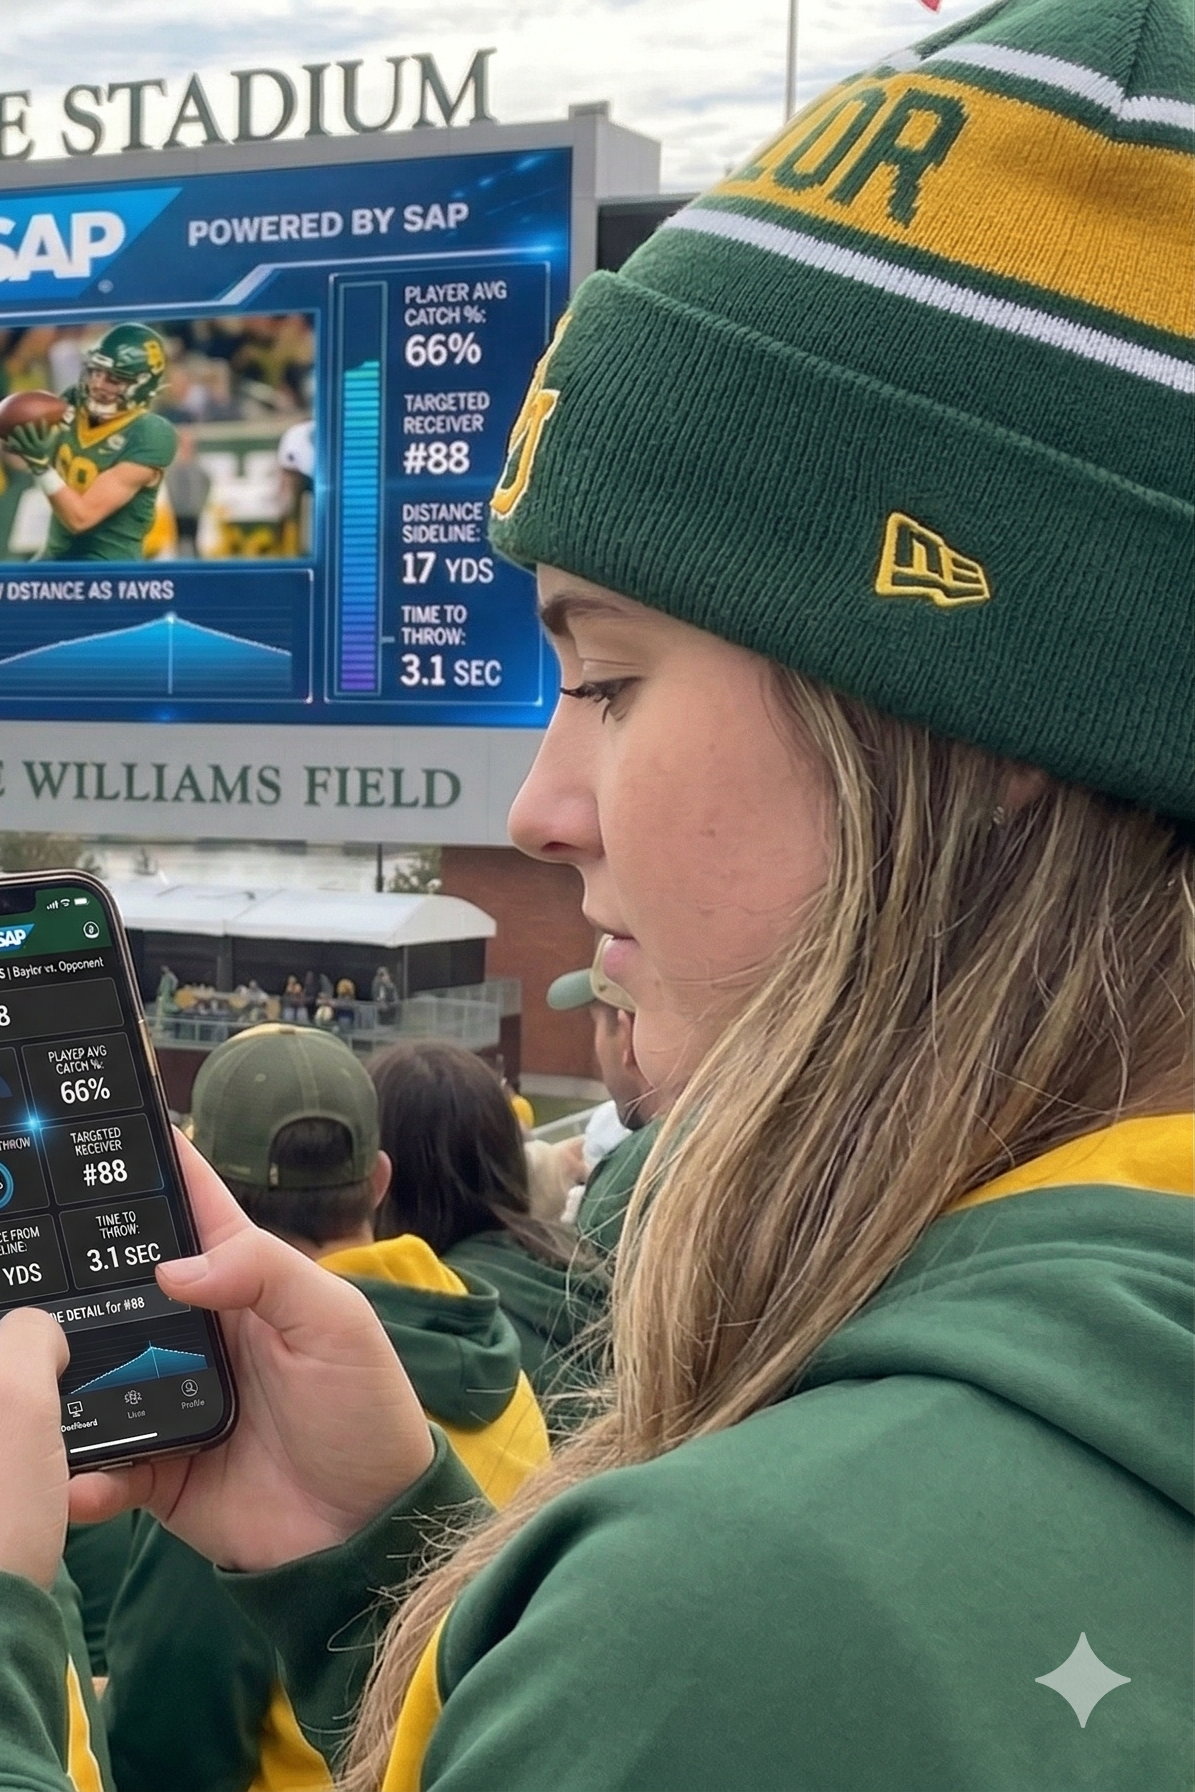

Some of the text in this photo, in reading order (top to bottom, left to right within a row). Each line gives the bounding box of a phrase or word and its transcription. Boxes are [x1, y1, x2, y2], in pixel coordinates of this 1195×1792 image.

[61, 48, 498, 156] STADIUM
[188, 203, 469, 247] POWERED BY SAP
[405, 281, 507, 304] PLAYER AVG
[404, 307, 461, 326] CATCH
[405, 332, 482, 366] 66%
[404, 392, 491, 412] TARGETED
[403, 414, 485, 434] RECEIVER
[403, 441, 470, 475] #88
[402, 502, 484, 522] DISTANCE
[401, 524, 481, 543] SIDELINE:
[402, 552, 494, 584] 17 YDS
[88, 581, 113, 600] AS
[401, 605, 468, 624] TIME TO
[401, 627, 466, 645] THROW:
[400, 654, 502, 687] 3.1 SEC
[22, 760, 282, 805] WILLIAMS
[304, 766, 462, 809] FIELD
[87, 1044, 107, 1058] AVG
[60, 1076, 111, 1104] 66%
[83, 1158, 128, 1187] #88
[121, 1210, 136, 1223] TO
[10, 1225, 41, 1241] FROM
[86, 1242, 162, 1273] 3.1 SEC
[1, 1262, 43, 1287] YDS
[67, 1304, 105, 1322] DETAIL
[105, 1301, 122, 1315] for
[123, 1296, 145, 1311] #88
